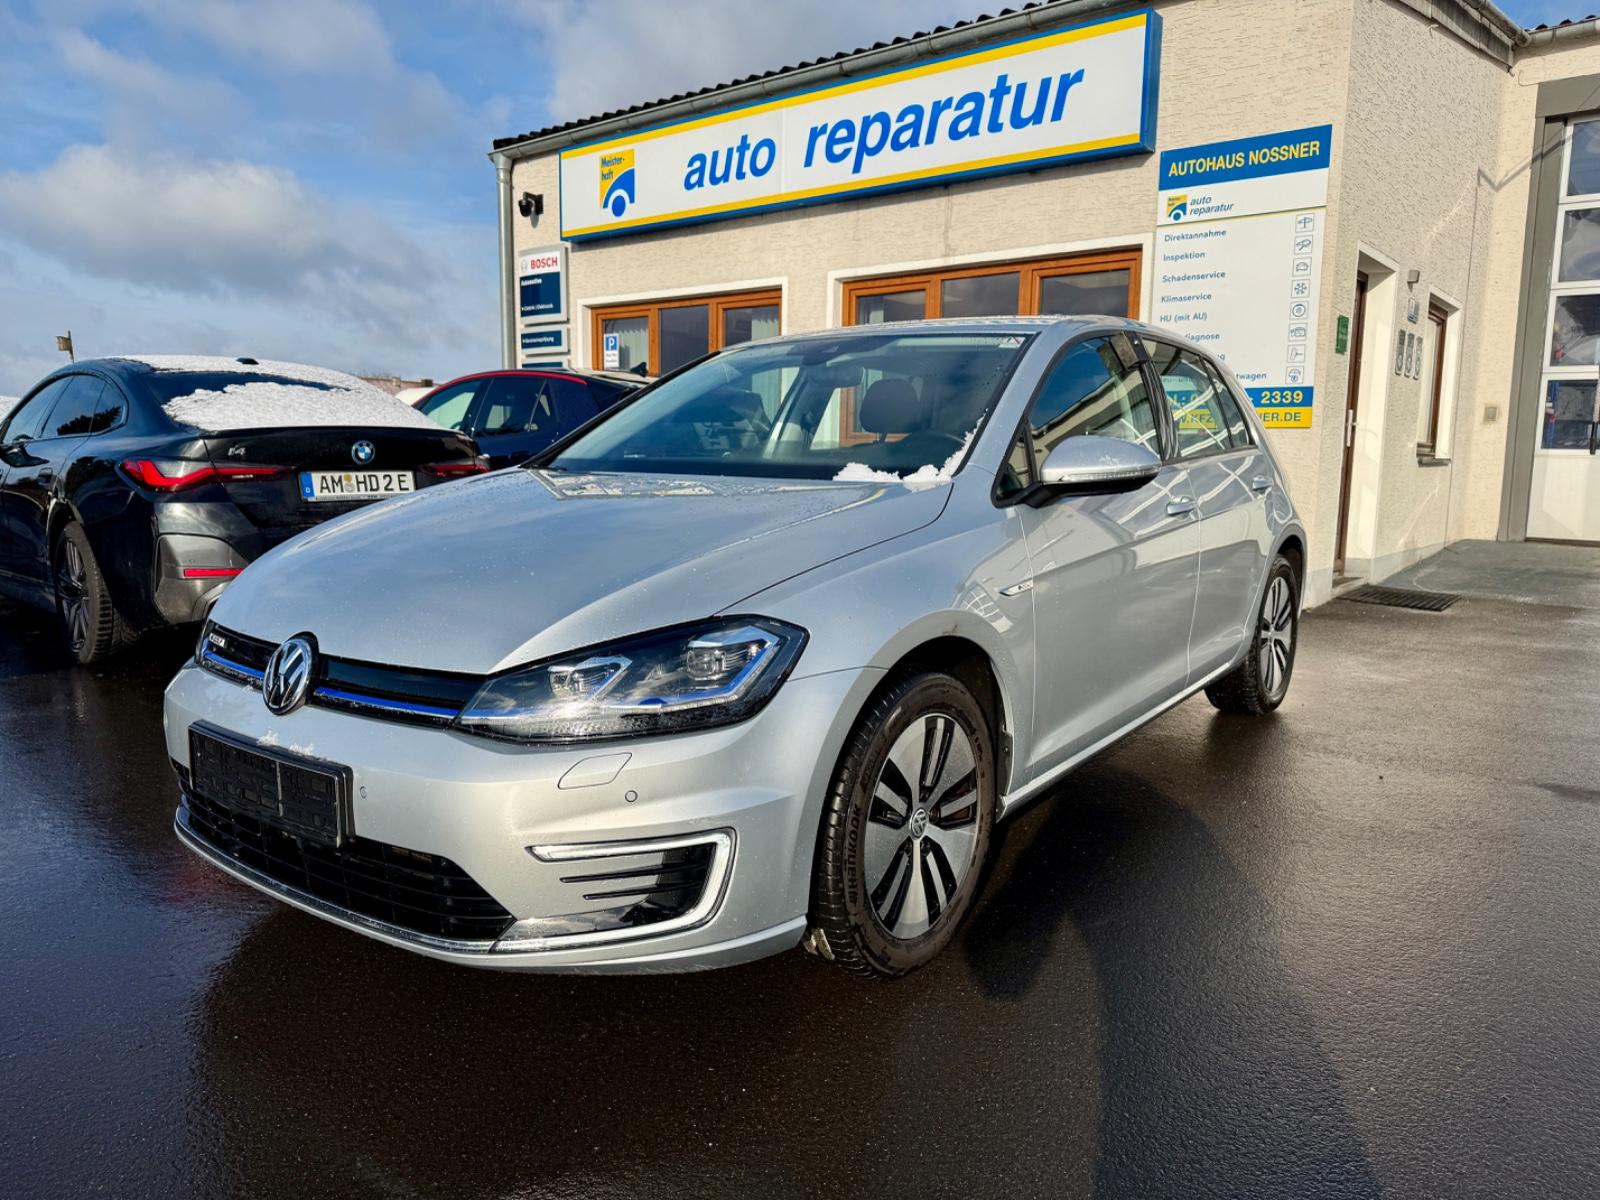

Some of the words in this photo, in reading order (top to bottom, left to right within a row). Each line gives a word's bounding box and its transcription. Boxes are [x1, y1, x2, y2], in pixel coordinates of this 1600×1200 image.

[683, 134, 776, 191] auto
[803, 68, 1085, 175] reparatur
[1168, 152, 1245, 177] AUTOHAUS
[1249, 140, 1320, 165] NOSSNER
[1190, 196, 1212, 206] auto
[1190, 203, 1234, 216] reparatur
[1164, 229, 1227, 242] Direktannahme
[530, 256, 558, 270] BOSCH
[1163, 251, 1206, 262] Inspektion
[1162, 271, 1226, 283] Schadenservice
[1161, 292, 1212, 303] Klimaservice
[1160, 314, 1172, 323] HU
[1174, 314, 1190, 323] (mit
[1193, 312, 1208, 321] AU)
[1260, 390, 1303, 404] 2339
[1259, 411, 1302, 422] ER.DE
[319, 475, 344, 494] AM
